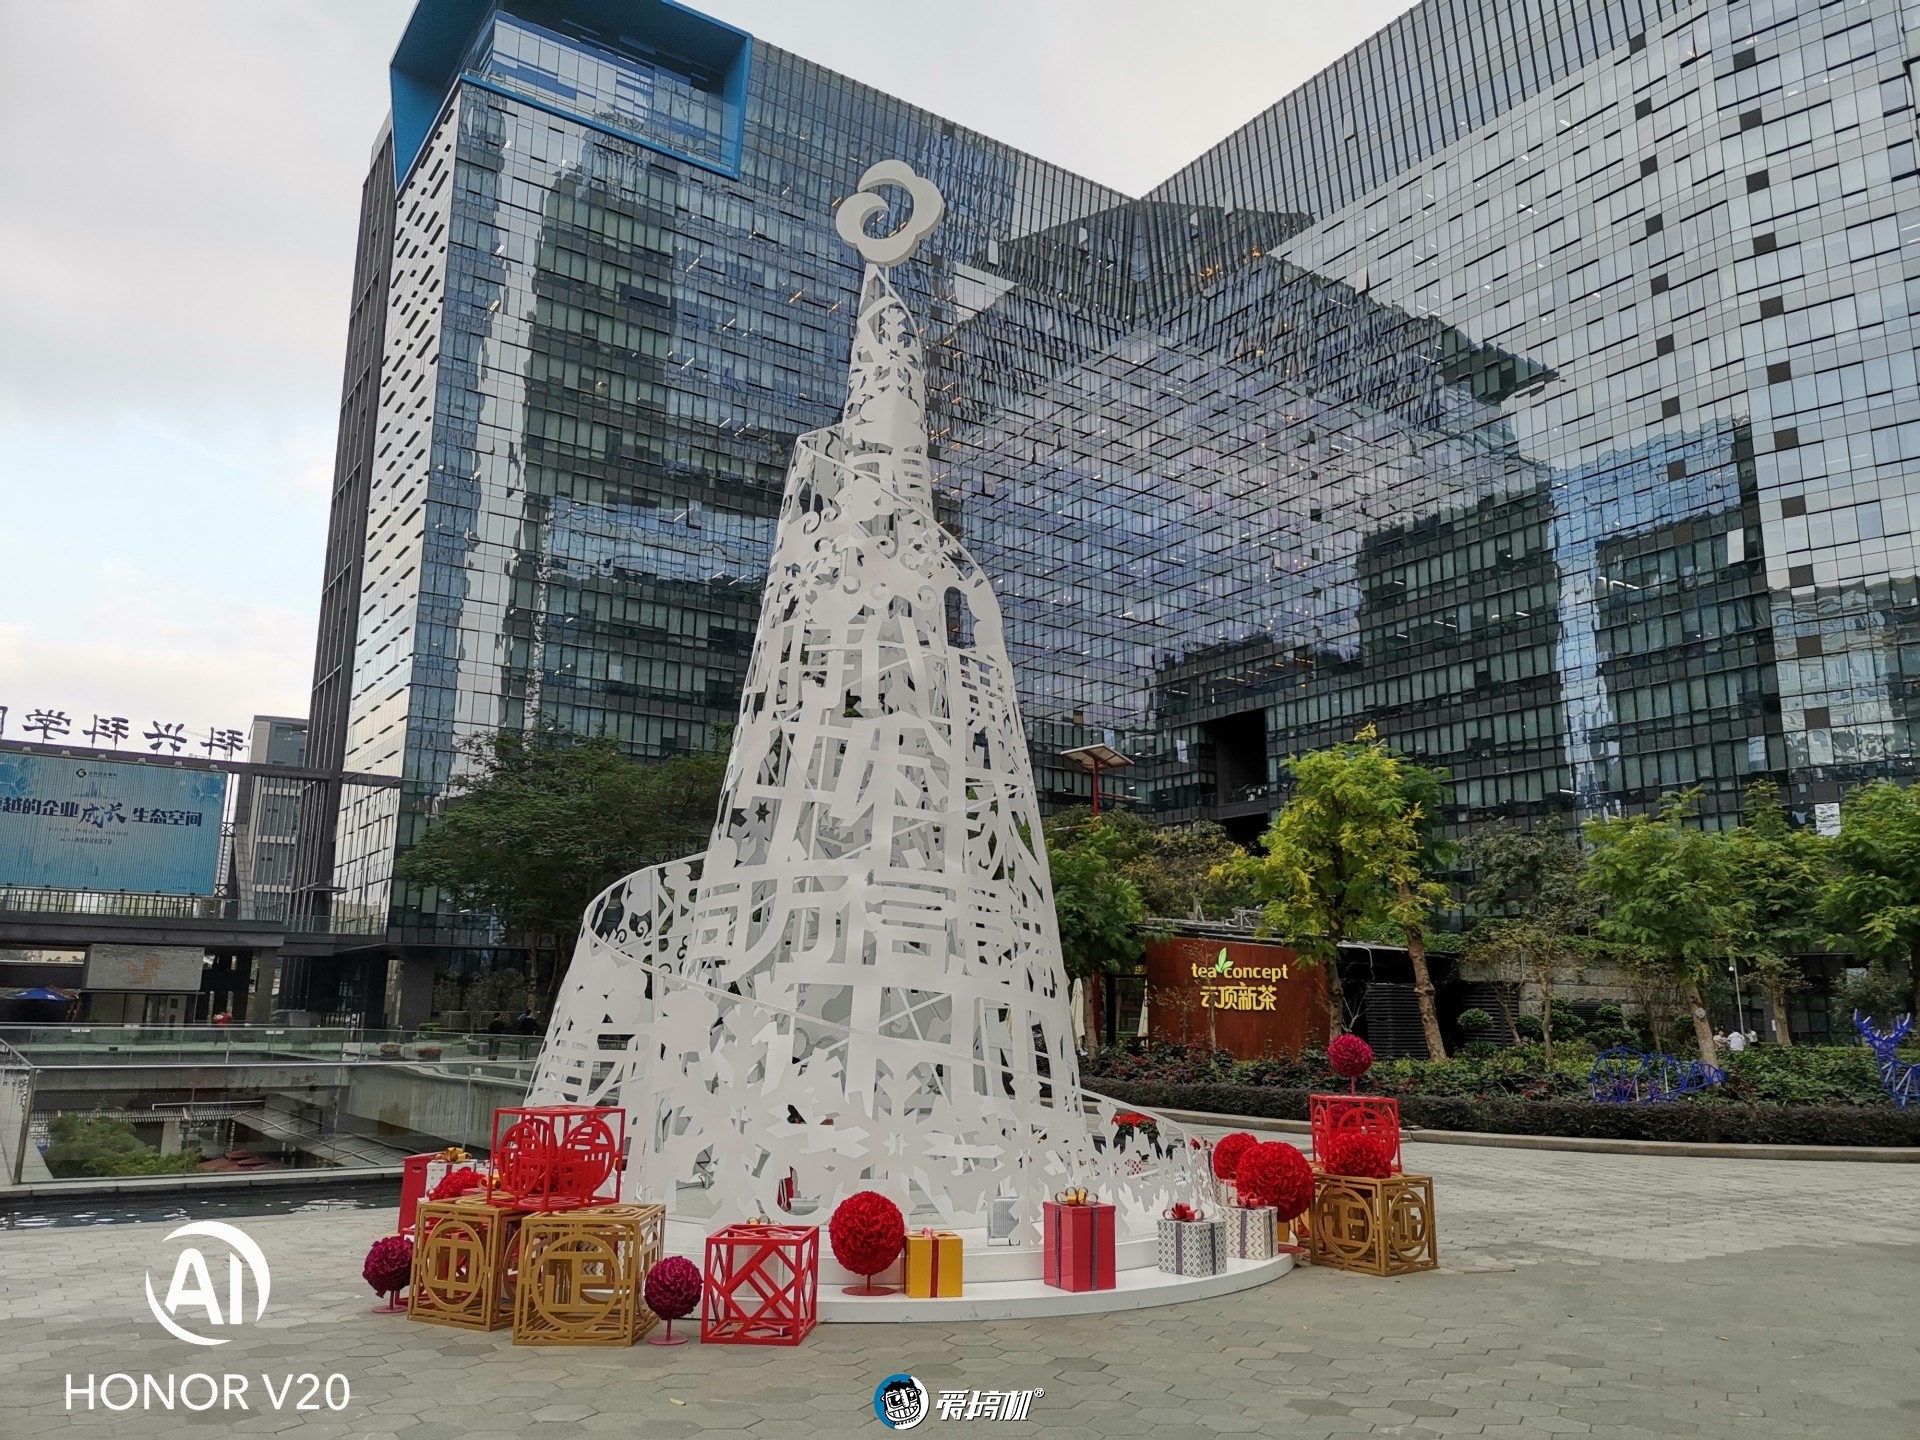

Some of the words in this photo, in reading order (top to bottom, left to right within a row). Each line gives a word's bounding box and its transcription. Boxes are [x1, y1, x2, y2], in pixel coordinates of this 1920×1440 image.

[1191, 962, 1217, 979] tea
[1223, 963, 1289, 982] concept
[1200, 981, 1277, 1011] 云顶新茶
